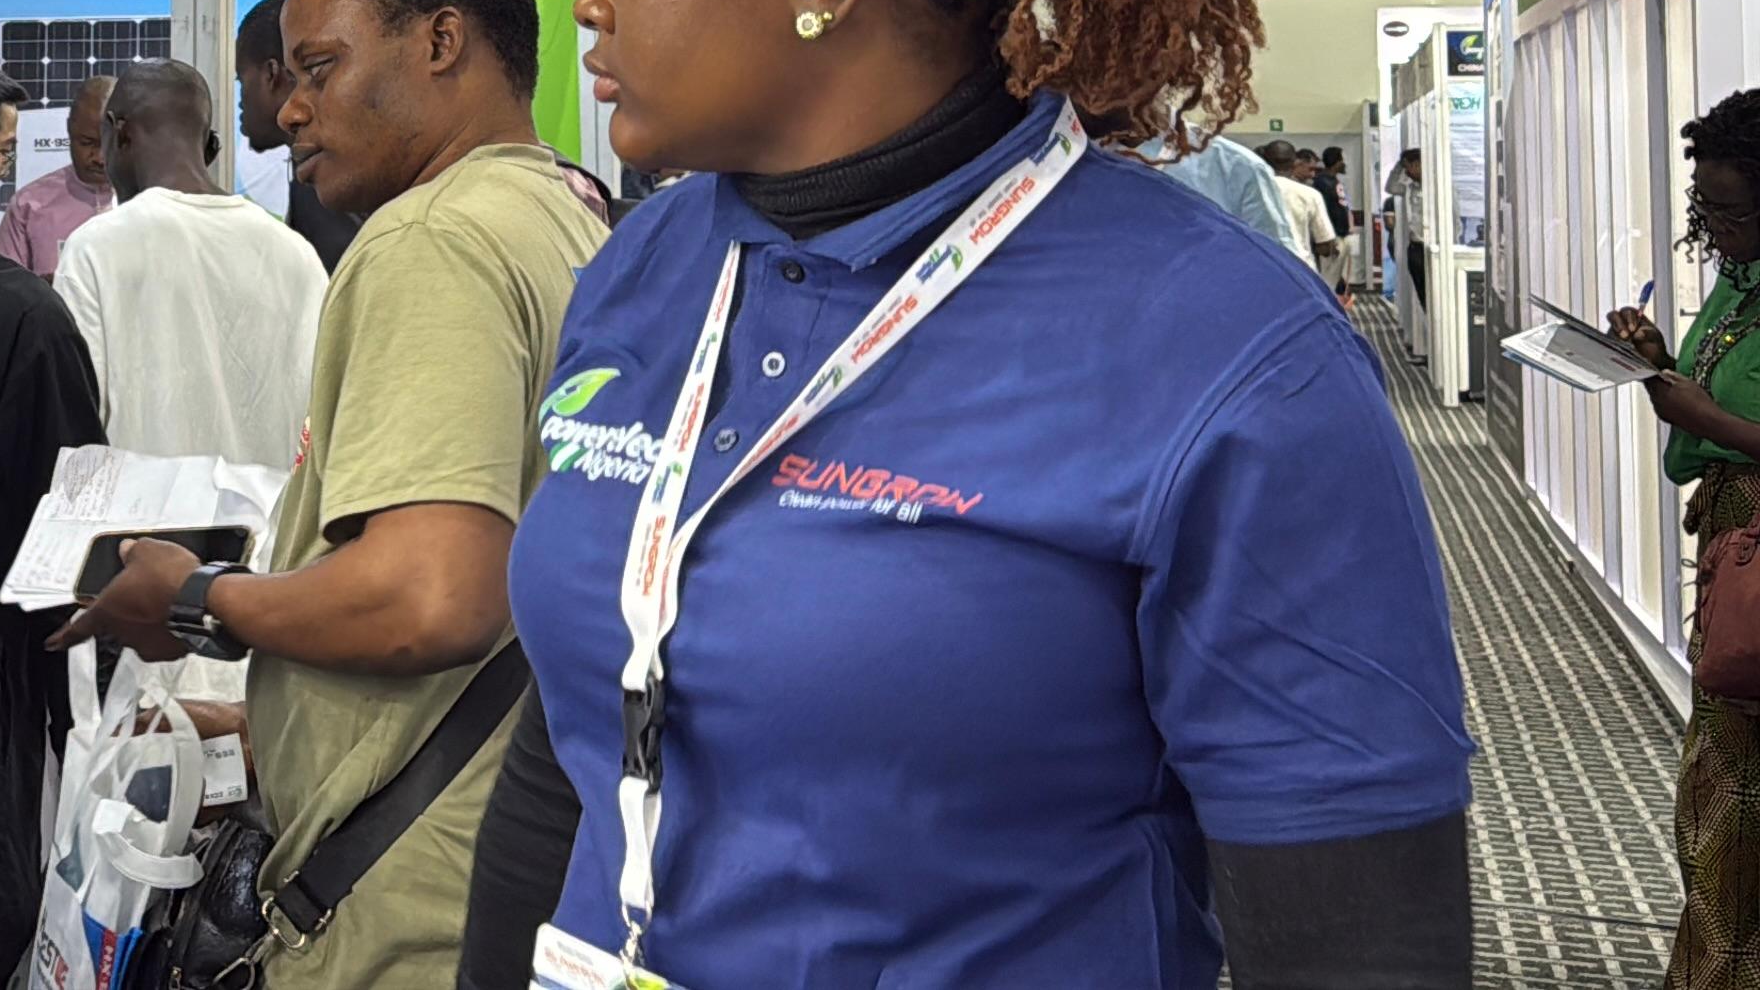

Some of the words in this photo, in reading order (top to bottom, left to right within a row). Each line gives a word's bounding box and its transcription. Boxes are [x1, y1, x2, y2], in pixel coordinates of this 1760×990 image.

[969, 176, 1036, 244] SUNGROW
[771, 453, 983, 515] SUNGROW
[896, 501, 923, 524] all
